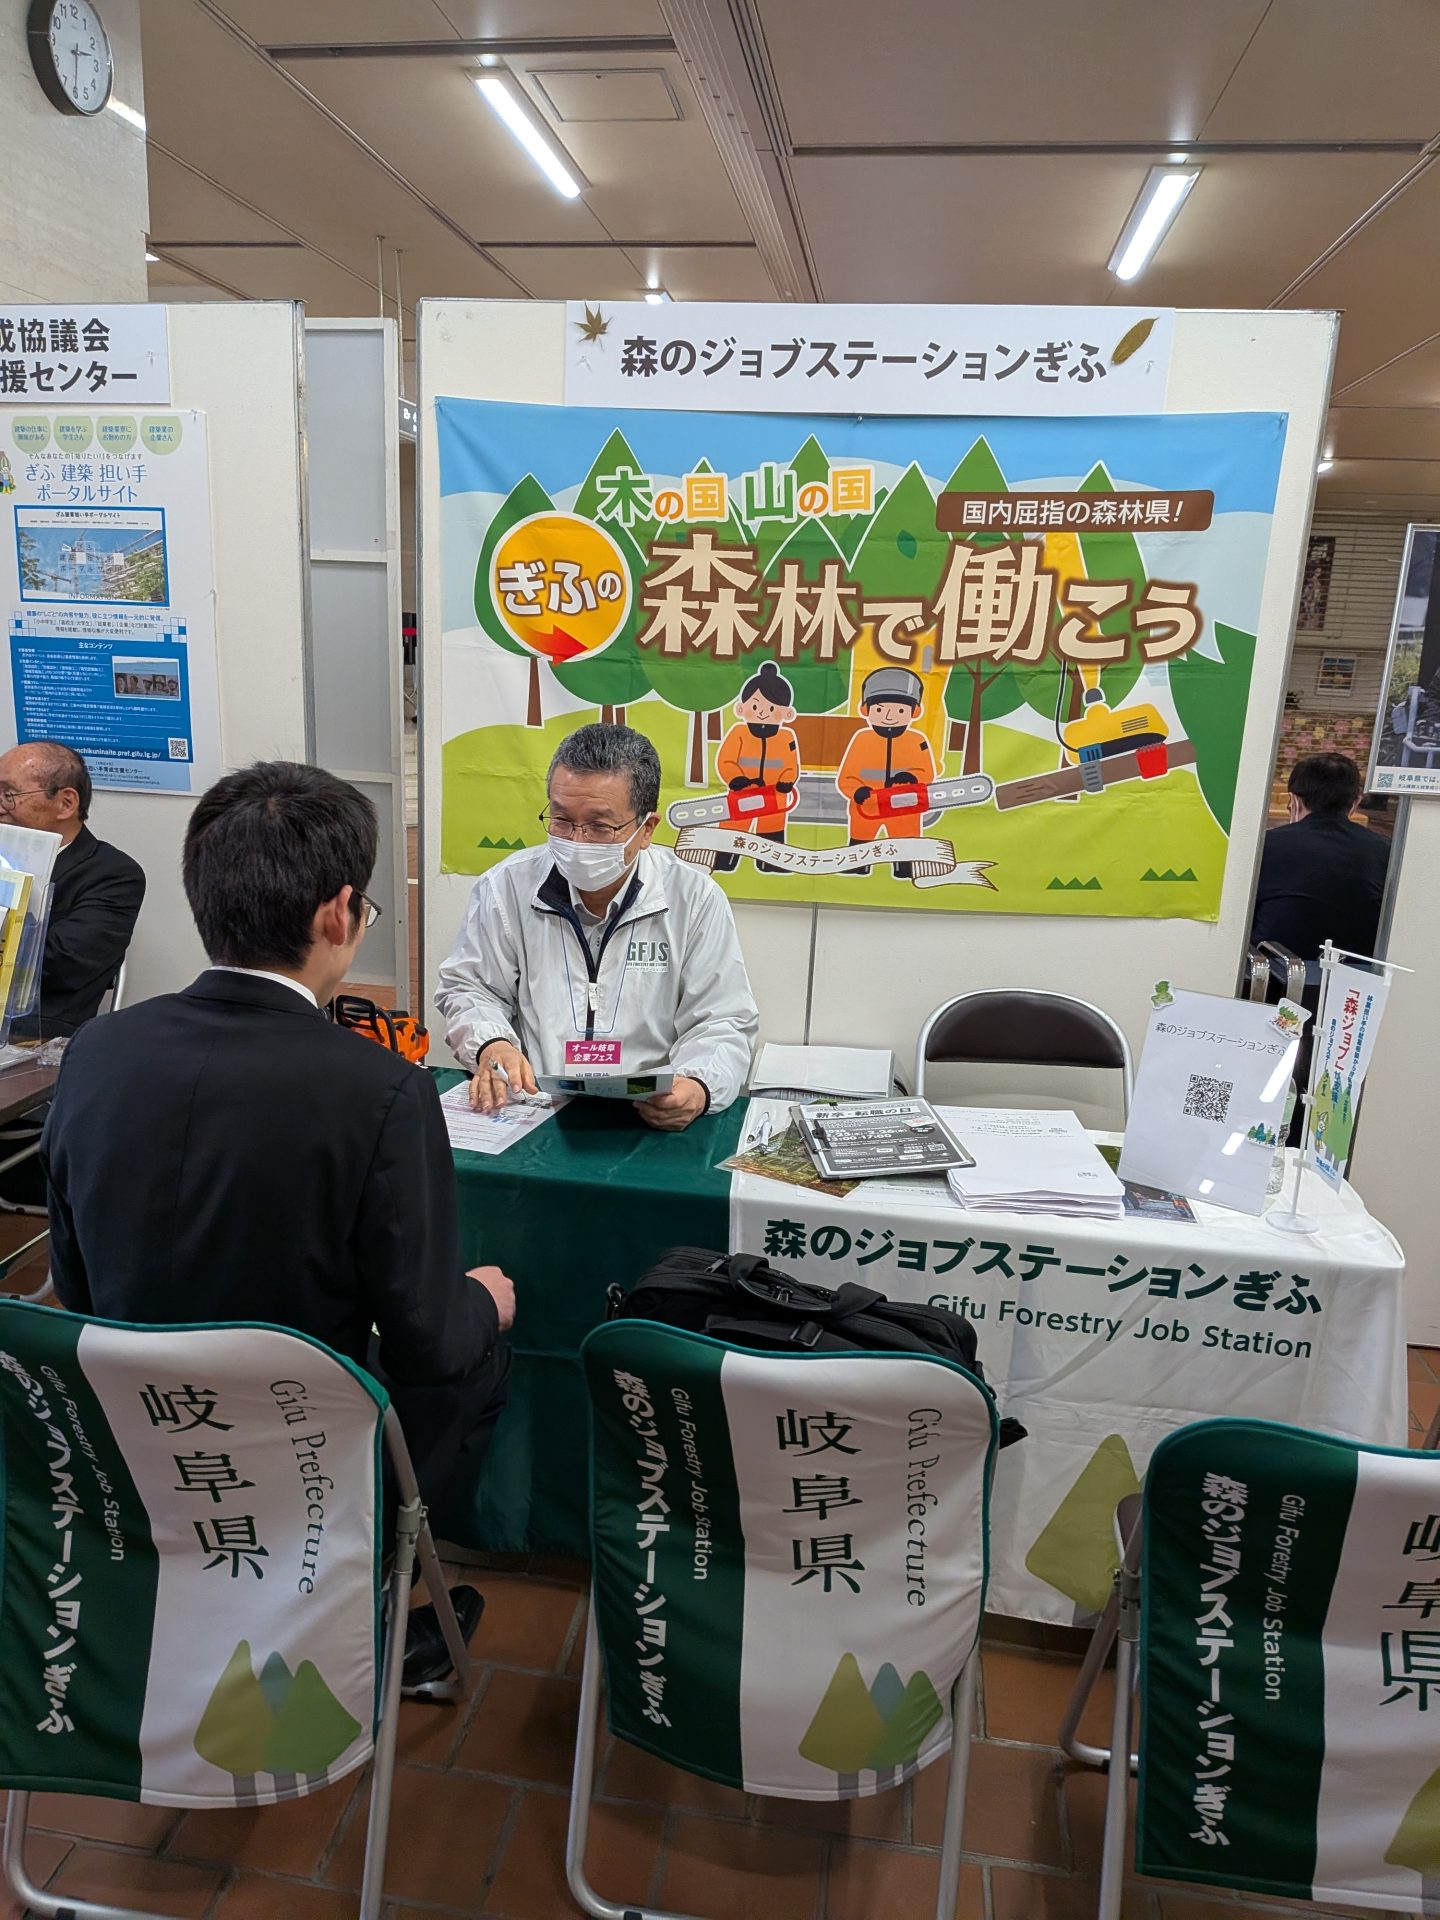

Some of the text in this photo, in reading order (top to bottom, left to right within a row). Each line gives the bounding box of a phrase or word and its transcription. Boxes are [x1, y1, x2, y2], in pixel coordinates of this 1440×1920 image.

[60, 4, 66, 18] 11
[70, 4, 79, 20] 12
[83, 18, 87, 30] 1
[90, 37, 95, 50] 2
[94, 60, 98, 72] 3
[62, 74, 68, 86] 7
[91, 78, 96, 91] 4
[72, 86, 78, 99] 6
[84, 87, 89, 100] 5
[620, 335, 1108, 385] 森のジョブステーションぎふ
[0, 360, 137, 393] 援センター
[26, 463, 147, 483] ぎふ 建築 担い手
[37, 484, 138, 502] ポータルサイト
[597, 462, 875, 526] 木の国 山の国
[961, 499, 1184, 525] 国内屈指の森林県!
[68, 593, 117, 601] INFORMATION
[499, 561, 622, 614] ぎふの
[640, 533, 1197, 662] 森林で働こう
[78, 642, 113, 650] 主なコンテンツ
[732, 835, 899, 867] 森のジョブステーションぎふ
[626, 941, 669, 962] GFJS
[572, 1044, 616, 1052] オール岐阜
[573, 1054, 613, 1062] 企業フェス
[763, 1218, 1322, 1317] 森のジョブステーションぎふ
[999, 1300, 1123, 1342] Forestry
[1133, 1317, 1190, 1344] Job
[1202, 1325, 1312, 1359] Station
[40, 1365, 126, 1562] Gifu Forestry Job Station
[139, 1383, 273, 1581] 岐阜県
[268, 1380, 334, 1595] Gifu Prefecture
[670, 1387, 714, 1580] Gifu Forestry Job Station
[775, 1408, 866, 1594] 岐阜県
[906, 1408, 942, 1607] Gifu Prefecture
[1262, 1494, 1306, 1702] Gifu Forestry Job Station
